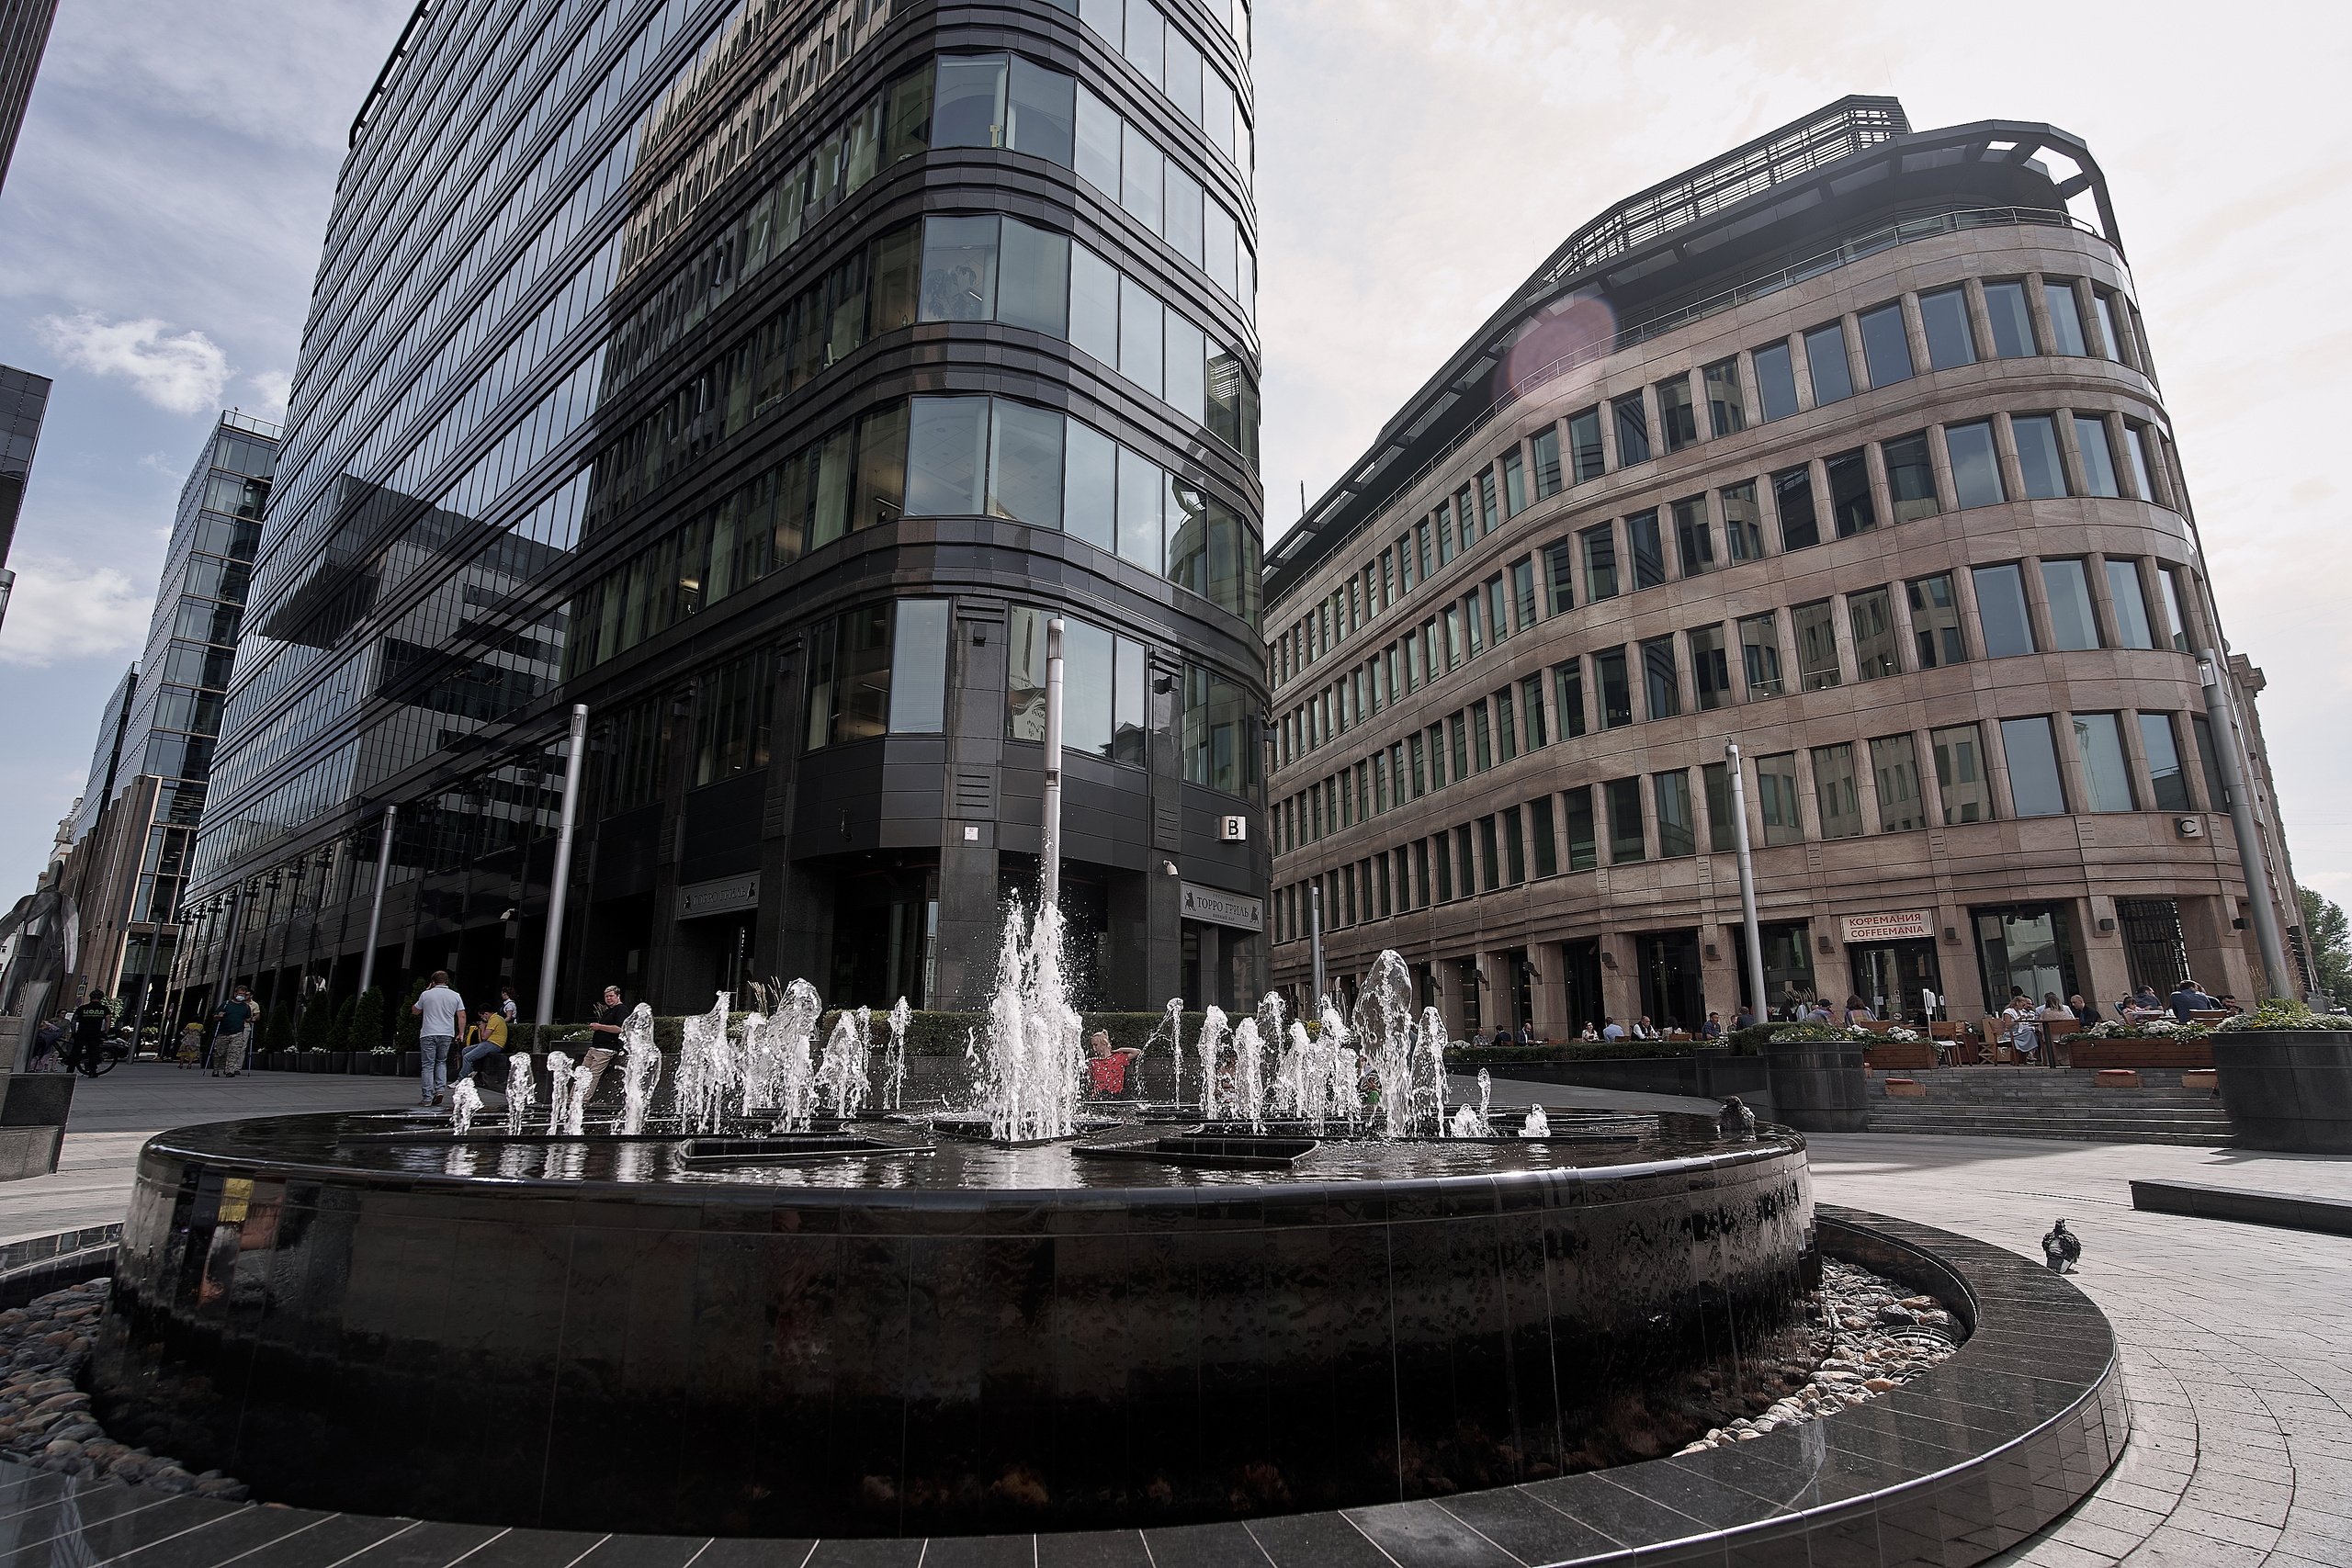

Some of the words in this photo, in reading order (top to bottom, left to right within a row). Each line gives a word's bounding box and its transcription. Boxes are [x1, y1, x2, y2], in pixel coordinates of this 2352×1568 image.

[1228, 819, 1238, 835] B
[2180, 819, 2197, 834] C
[1197, 897, 1223, 912] ТОРРО
[1225, 903, 1250, 918] ГРИЛЬ
[1849, 913, 1921, 926] КОФЕМАНИЯ
[1850, 925, 1924, 938] COFFEEMANIA
